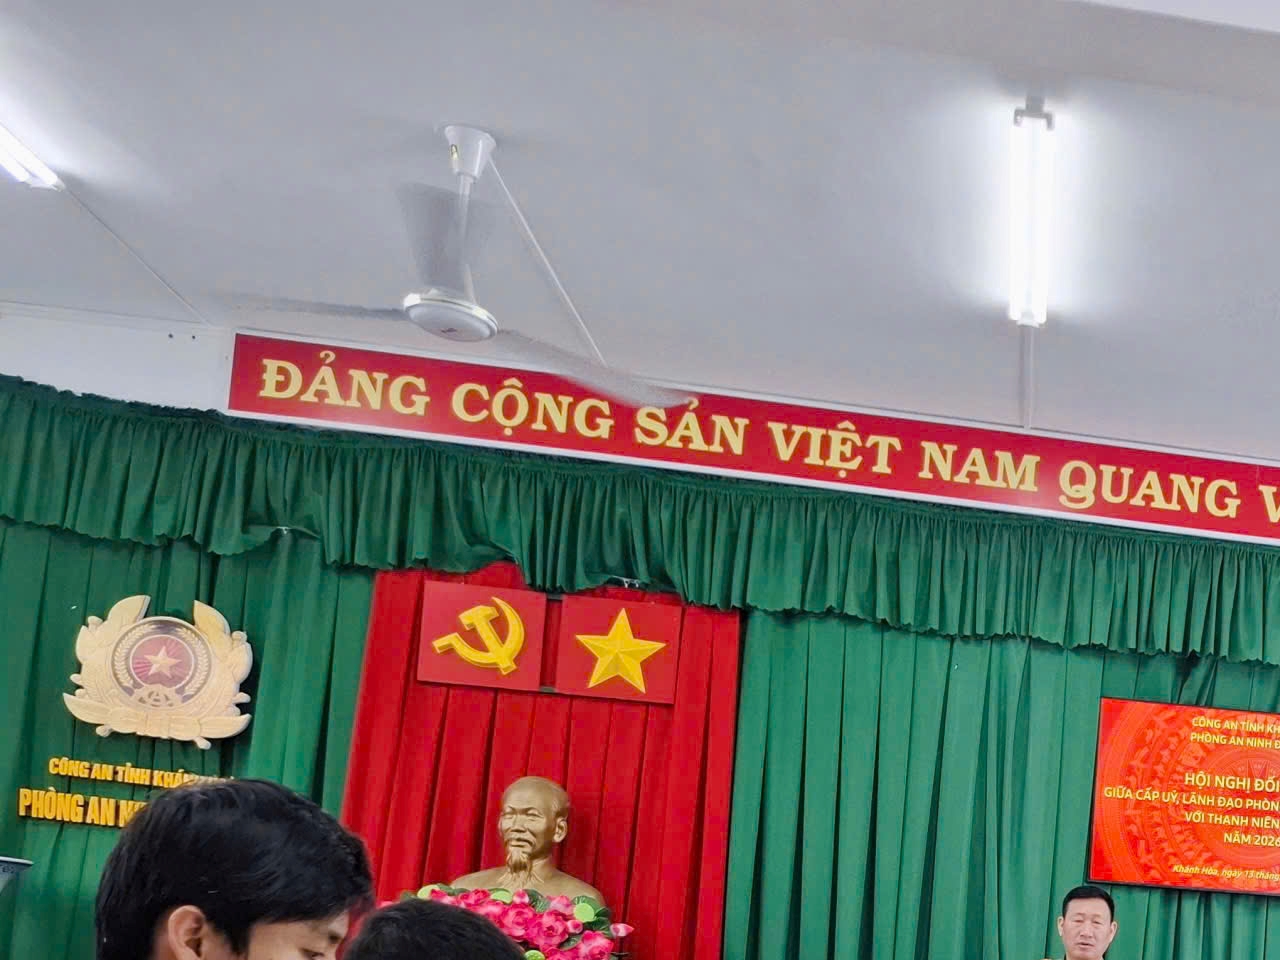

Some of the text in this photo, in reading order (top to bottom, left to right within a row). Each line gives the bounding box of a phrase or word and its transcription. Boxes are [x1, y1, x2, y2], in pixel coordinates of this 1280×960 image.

[258, 350, 431, 417] ĐẢNG
[451, 376, 615, 440] CỘNG
[634, 397, 749, 456] SẢN
[767, 420, 903, 479] VIỆT
[918, 441, 1041, 493] NAM
[1058, 460, 1242, 519] QUANG
[1192, 716, 1221, 729] CÔNG
[1223, 719, 1238, 730] AN
[1240, 718, 1263, 732] TỈNH
[1190, 731, 1227, 744] PHÒNG
[1228, 735, 1244, 746] AN
[1246, 736, 1272, 749] NINH
[49, 756, 91, 779] CÔNG
[90, 763, 114, 781] AN
[115, 762, 152, 786] TỈNH
[1185, 770, 1211, 790] HỘI
[1214, 775, 1251, 794] NGHỊ
[1254, 775, 1280, 792] ĐỐI
[18, 786, 85, 824] PHÒNG
[85, 795, 116, 827] AN
[1104, 785, 1133, 799] GIỮA
[1135, 787, 1160, 801] CẤP
[1182, 792, 1215, 807] LÃNH
[1217, 796, 1243, 811] ĐẠO
[1185, 811, 1205, 823] VỚI
[1207, 812, 1249, 826] THANH
[1251, 816, 1280, 829] NIÊN
[1223, 830, 1251, 844] NĂM
